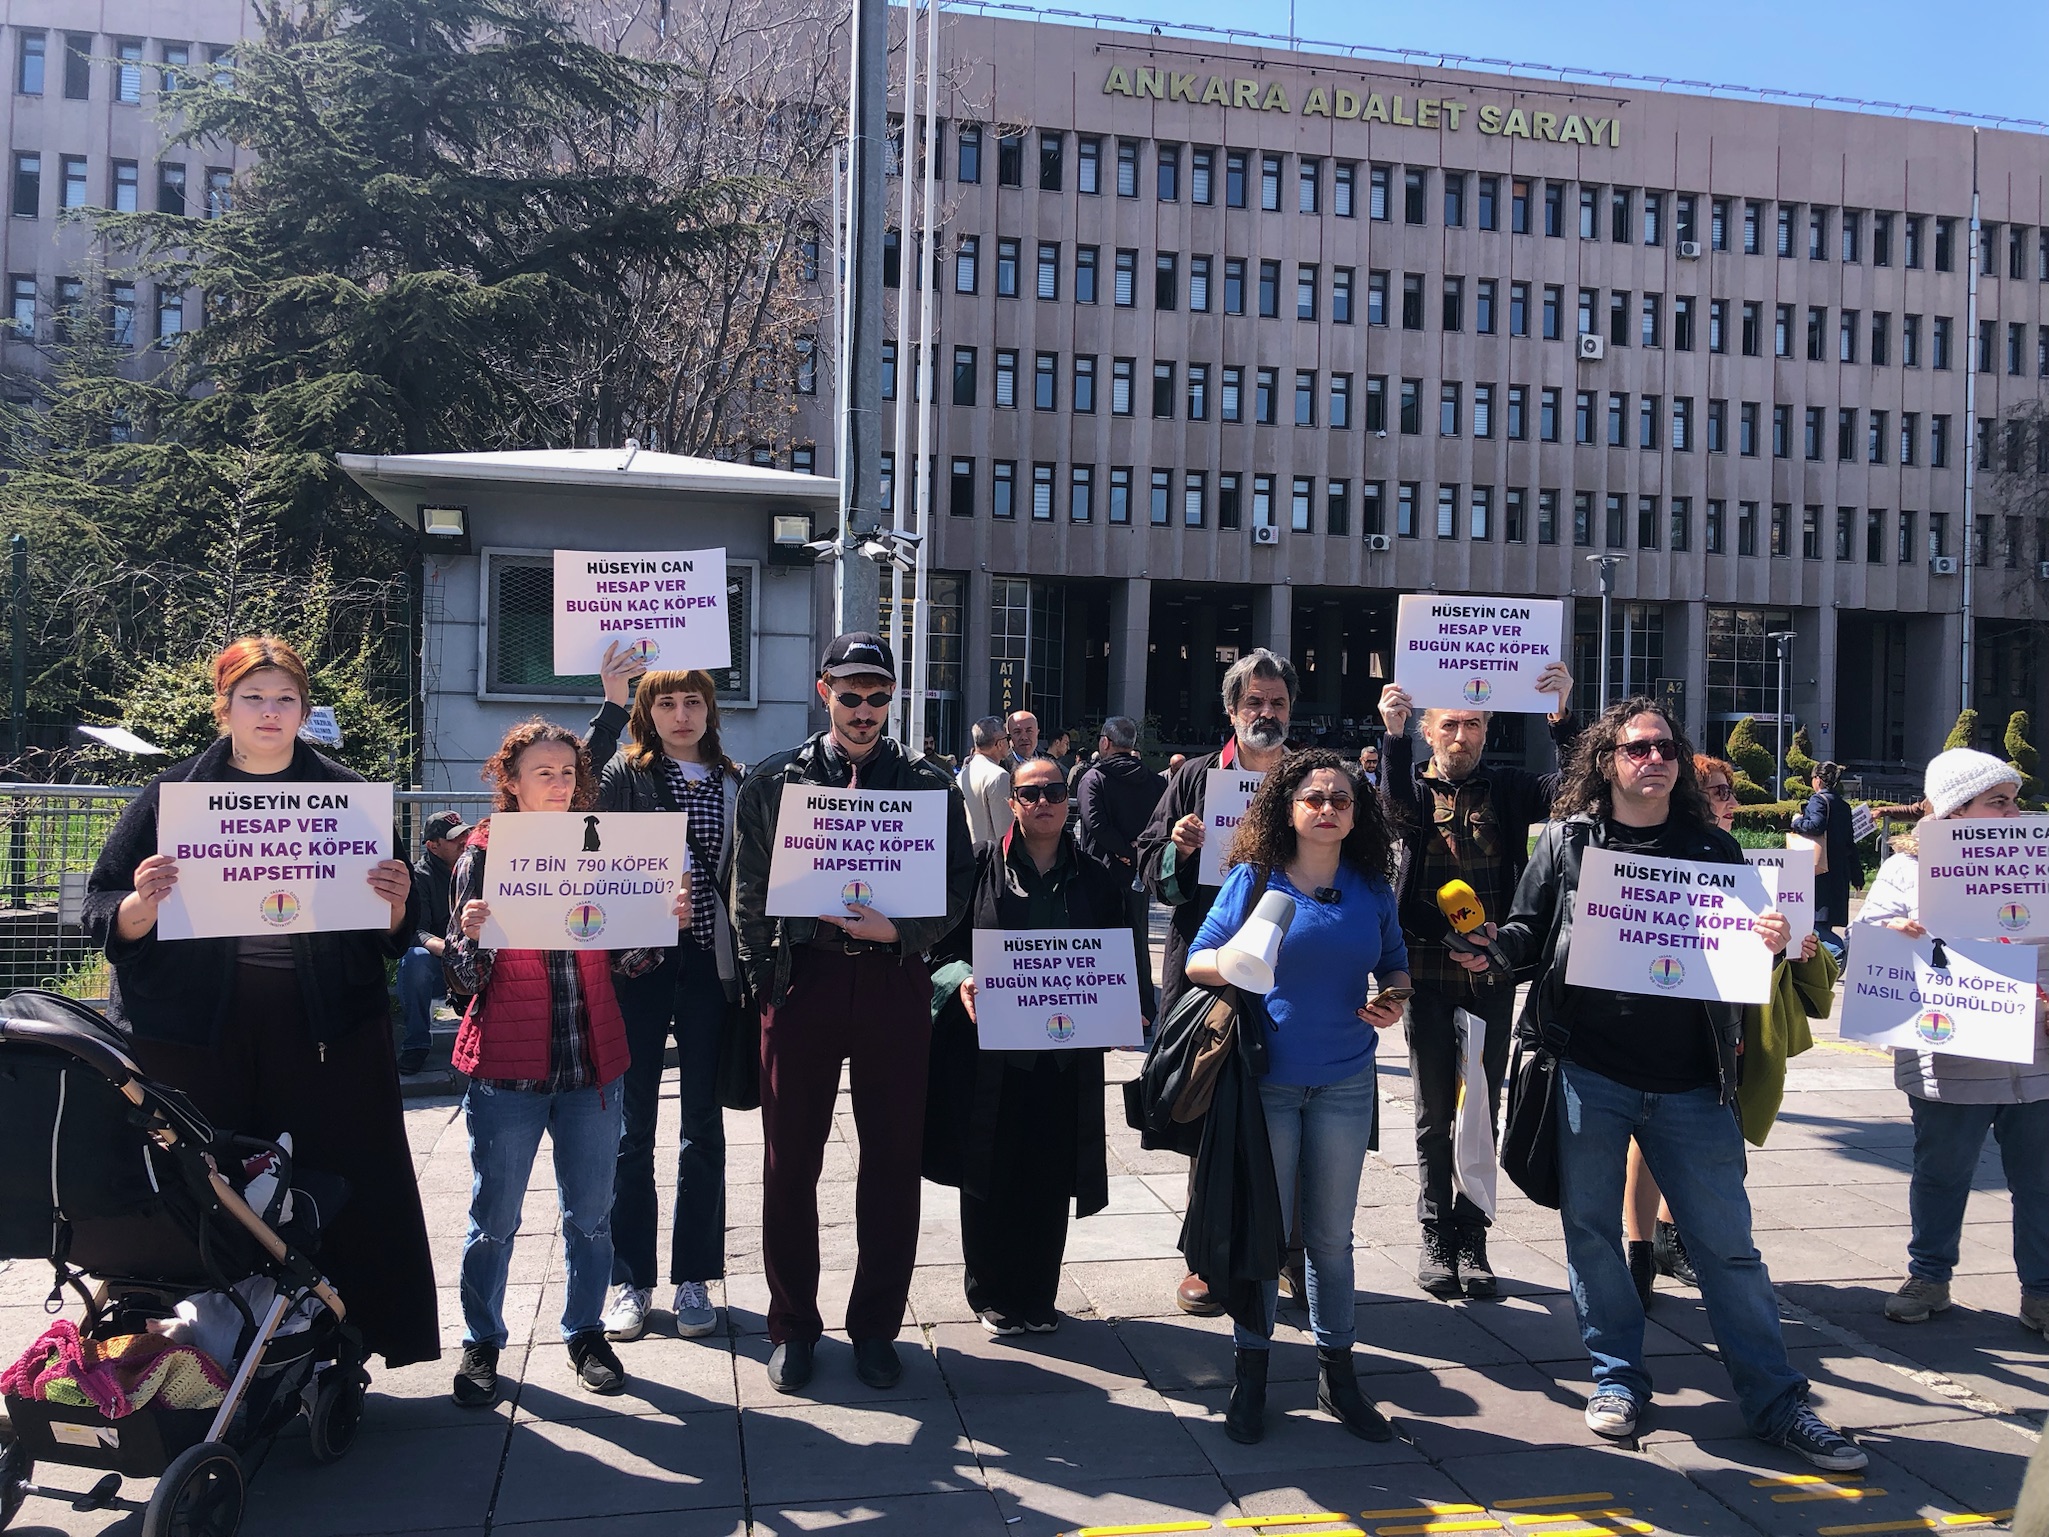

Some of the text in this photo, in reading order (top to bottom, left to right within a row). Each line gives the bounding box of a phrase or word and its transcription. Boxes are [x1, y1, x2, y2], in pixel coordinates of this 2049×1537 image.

[1103, 65, 1620, 147] ANKARA ADALET SARAYI
[587, 559, 694, 574] HÜSEYİN CAN
[596, 579, 686, 594] HESAP VER
[566, 594, 717, 614] BUGÜN KAÇ KÖPEK
[1431, 603, 1530, 620] HÜSEYİN CAN
[600, 613, 686, 631] HAPSETTİN
[1438, 623, 1522, 637] HESAP VER
[1409, 638, 1550, 656] BUGÜN KAÇ KÖPEK
[999, 662, 1014, 675] A1
[1438, 657, 1519, 672] HAPSETTİN
[1666, 681, 1683, 693] A2
[208, 791, 348, 811] HÜSEYİN CAN
[806, 794, 912, 813] HÜSEYİN CAN
[220, 817, 338, 834] HESAP VER
[813, 817, 904, 832] HESAP VER
[1952, 825, 2027, 841] HÜSEYİN
[177, 837, 378, 860] BUGÜN KAÇ KÖPEK
[784, 834, 935, 855] BUGÜN KAÇ KÖPEK
[1962, 845, 2049, 859] HESAP VE
[222, 861, 336, 882] HAPSETTİN
[509, 855, 669, 872] 17 BİN 790 KÖPEK
[813, 856, 902, 872] HAPSETTİN
[1930, 862, 1989, 878] BUGÜN
[1995, 864, 2030, 879] KAÇ
[1613, 862, 1736, 888] HÜSEYİN CAN
[499, 878, 674, 896] NASIL ÖLDÜRÜLDÜ?
[1965, 880, 2049, 895] HAPSETTİ
[1620, 886, 1724, 909] HESAP VER
[1587, 902, 1647, 923] BUGÜN
[1652, 911, 1690, 930] KAÇ
[1003, 936, 1102, 951] HÜSEYİN CAN
[1619, 928, 1720, 951] HAPSETTİN
[1013, 956, 1096, 970] HESAP VER
[985, 971, 1127, 990] BUGÜN KAÇ KÖPEK
[1867, 964, 2018, 994] 17 BİN 790 KÖPEK
[1017, 990, 1098, 1007] HAPSETTİN
[1857, 982, 2026, 1015] NASIL ÖLDÜRÜLDÜ?
